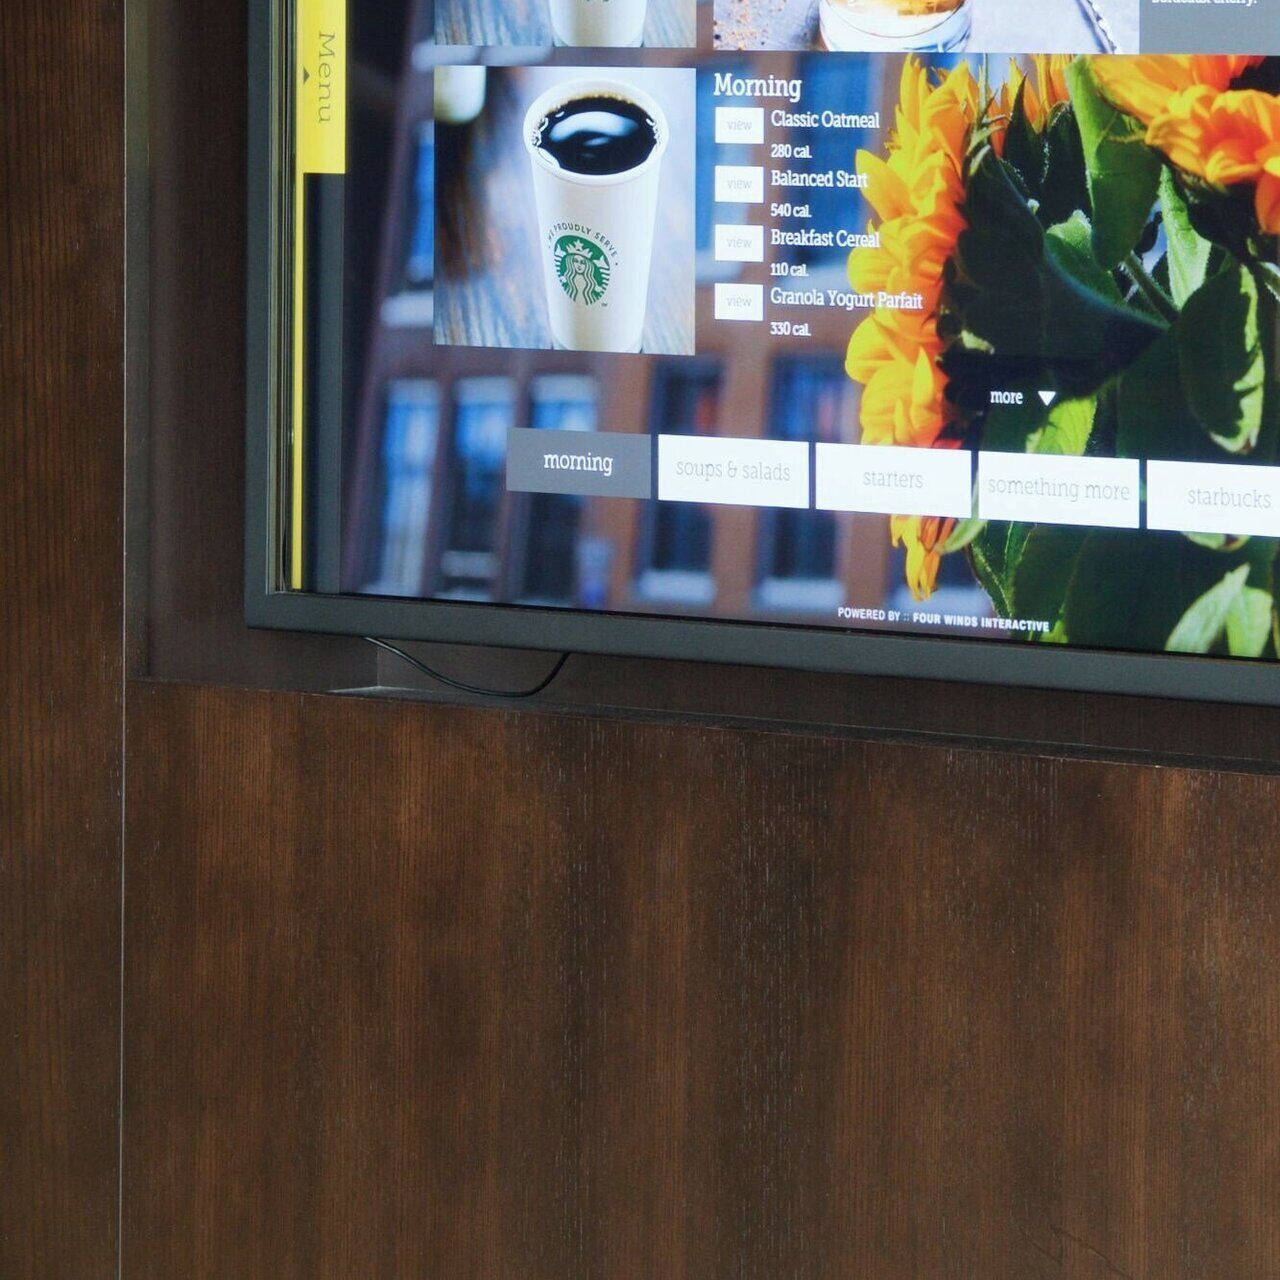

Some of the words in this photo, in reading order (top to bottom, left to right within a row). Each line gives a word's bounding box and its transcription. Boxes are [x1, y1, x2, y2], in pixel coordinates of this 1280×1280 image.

[318, 30, 336, 124] Menu
[713, 73, 802, 102] Morning
[726, 119, 752, 131] view
[771, 110, 818, 128] Classic
[821, 111, 880, 129] Oatmeal
[771, 144, 791, 158] 280
[793, 145, 813, 159] cal.
[726, 178, 752, 190] view
[771, 170, 833, 188] Balanced
[837, 171, 868, 188] Start
[770, 204, 790, 217] 540
[793, 205, 812, 218] cal.
[553, 223, 592, 234] PROUDLY
[595, 232, 618, 258] SERVE
[726, 237, 752, 249] view
[771, 229, 833, 247] Breakfast
[836, 230, 880, 248] Cereal
[770, 263, 788, 276] 110
[791, 264, 810, 277] cal.
[725, 296, 752, 308] view
[770, 287, 824, 306] Granola
[827, 289, 874, 311] Yogurt
[878, 292, 923, 309] Parfait
[770, 322, 790, 335] 330
[793, 323, 811, 336] cal.
[990, 389, 1024, 406] more
[544, 452, 614, 477] morning
[676, 460, 722, 482] soups
[728, 461, 737, 478] &
[742, 463, 791, 482] salads
[862, 469, 924, 489] starters
[987, 476, 1080, 504] something
[1085, 483, 1131, 502] more
[1187, 488, 1272, 510] starbucks
[838, 607, 886, 621] POWERED
[888, 610, 901, 621] BY
[913, 612, 941, 624] FOUR
[944, 615, 978, 627] WINDS
[981, 618, 1050, 632] INTERACTIVE
